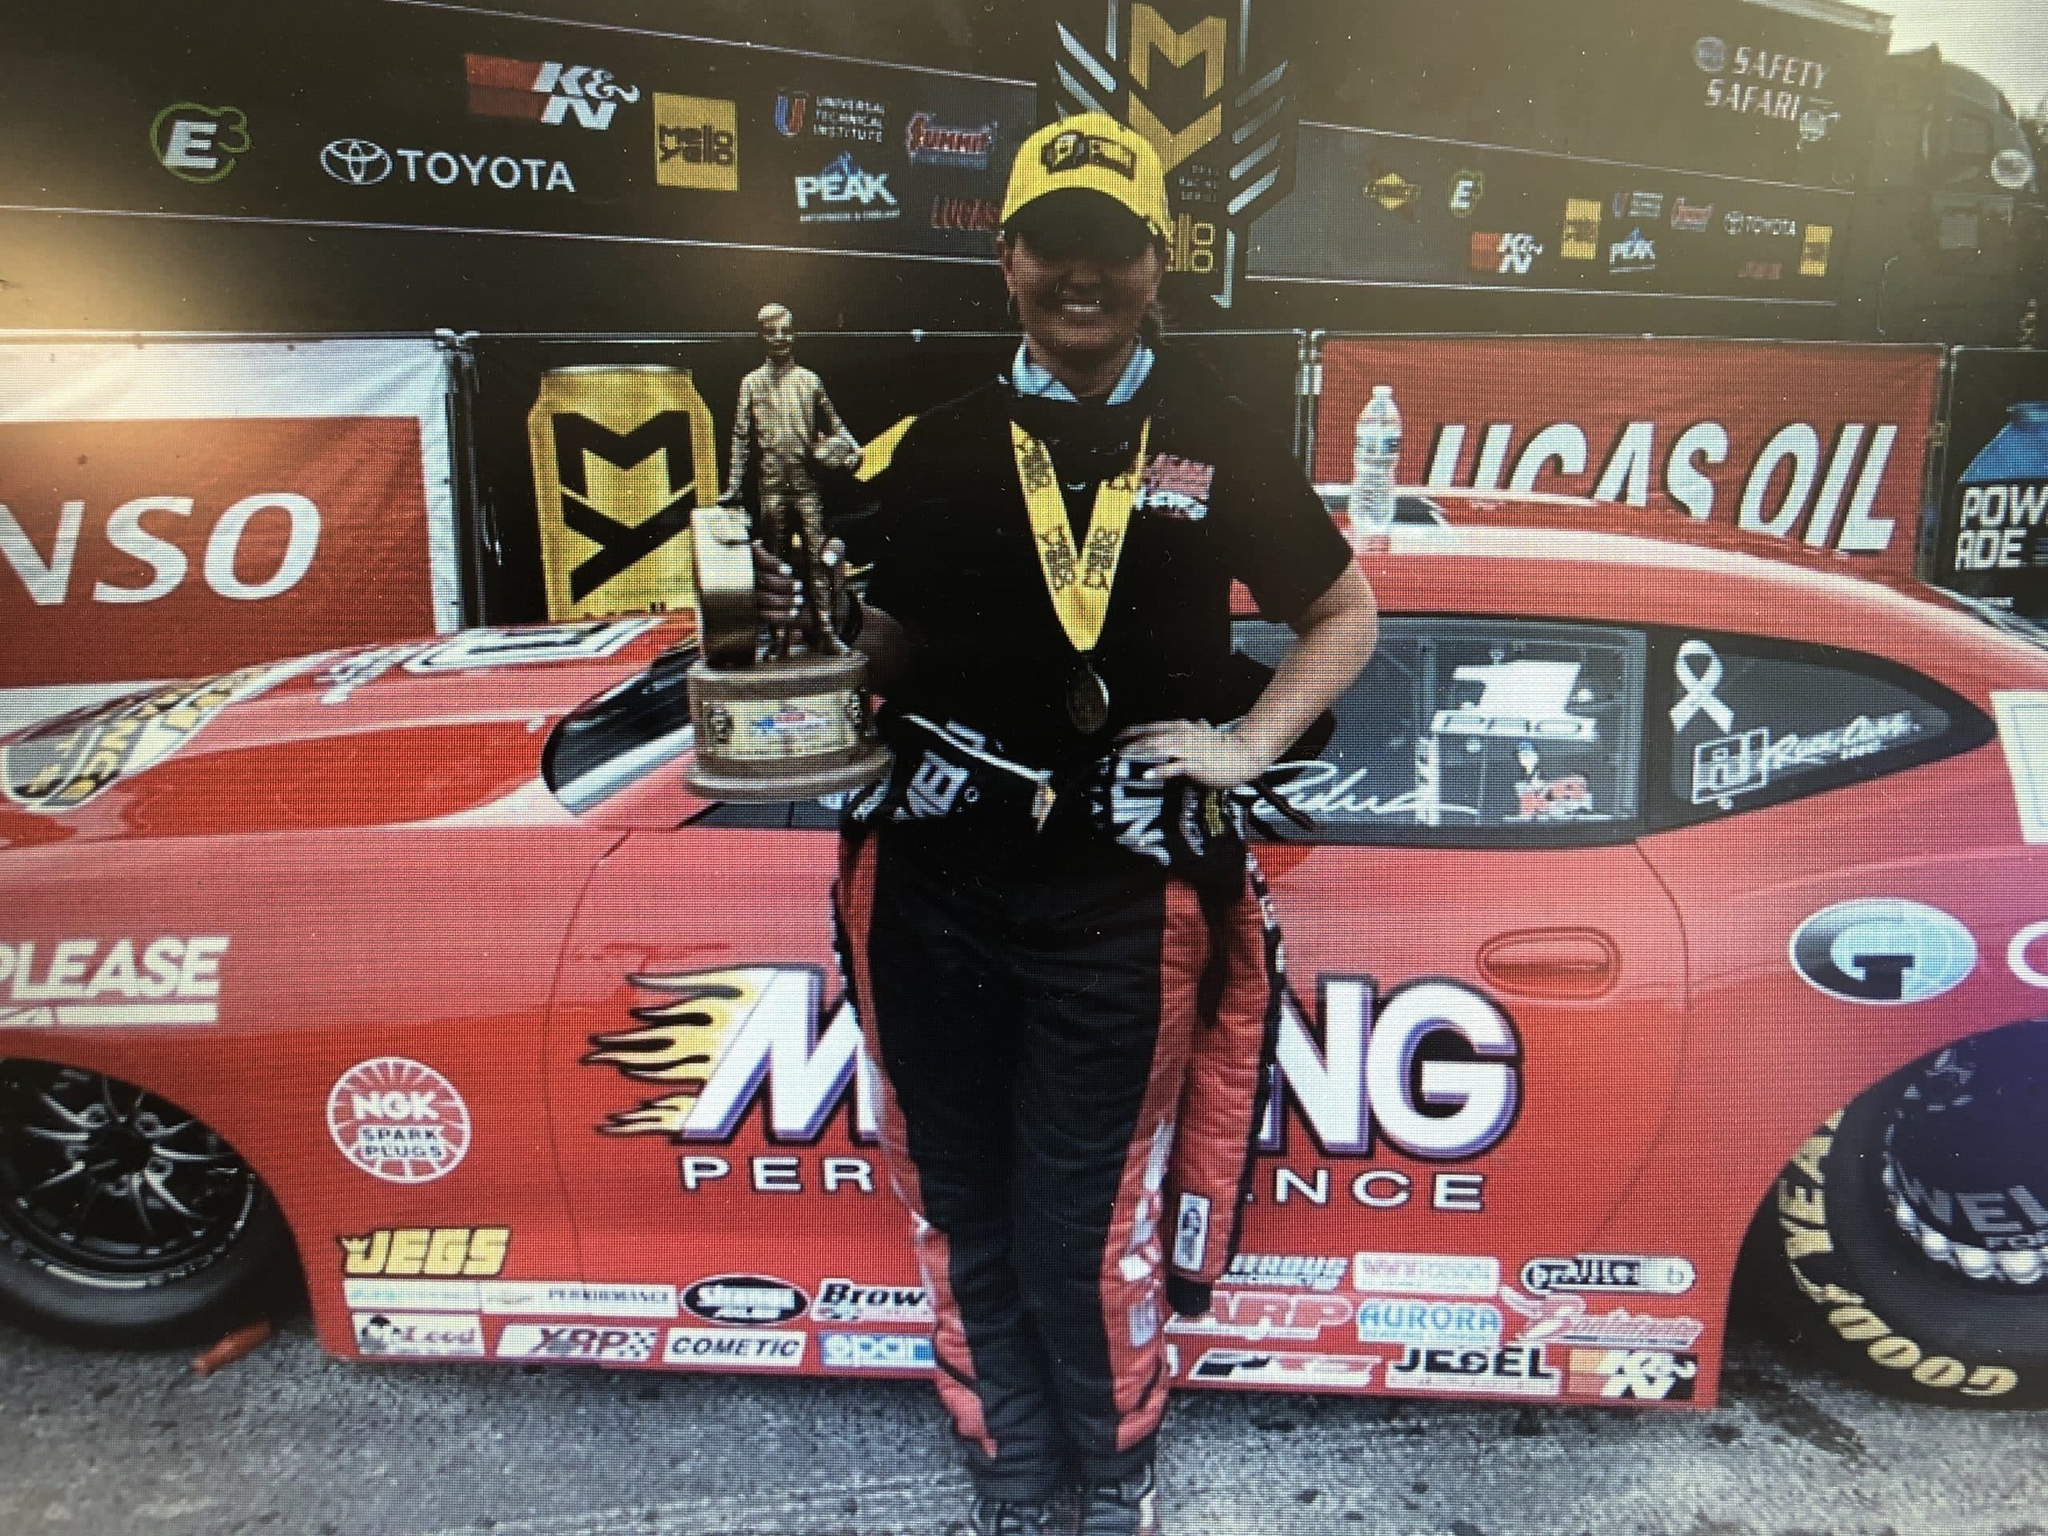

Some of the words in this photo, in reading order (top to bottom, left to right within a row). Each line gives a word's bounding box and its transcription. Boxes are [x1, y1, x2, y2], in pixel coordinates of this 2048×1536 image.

[1733, 46, 1832, 88] SAFETY
[532, 60, 641, 129] K&N
[1704, 78, 1800, 121] SAFARI
[396, 148, 577, 192] TOYOTA
[795, 173, 899, 209] PEAK
[1427, 422, 1730, 522] UCAS
[1737, 423, 1898, 551] OIL
[1954, 527, 2028, 571] ADE
[352, 1091, 441, 1121] NGK
[360, 1127, 441, 1144] SPARK
[363, 1142, 443, 1159] PLUGS
[345, 1227, 511, 1276] JEGS
[822, 1283, 931, 1308] Brow
[1359, 1302, 1500, 1331] AURORA
[671, 1336, 800, 1358] COMETIC
[1392, 1346, 1555, 1380] JESEL
